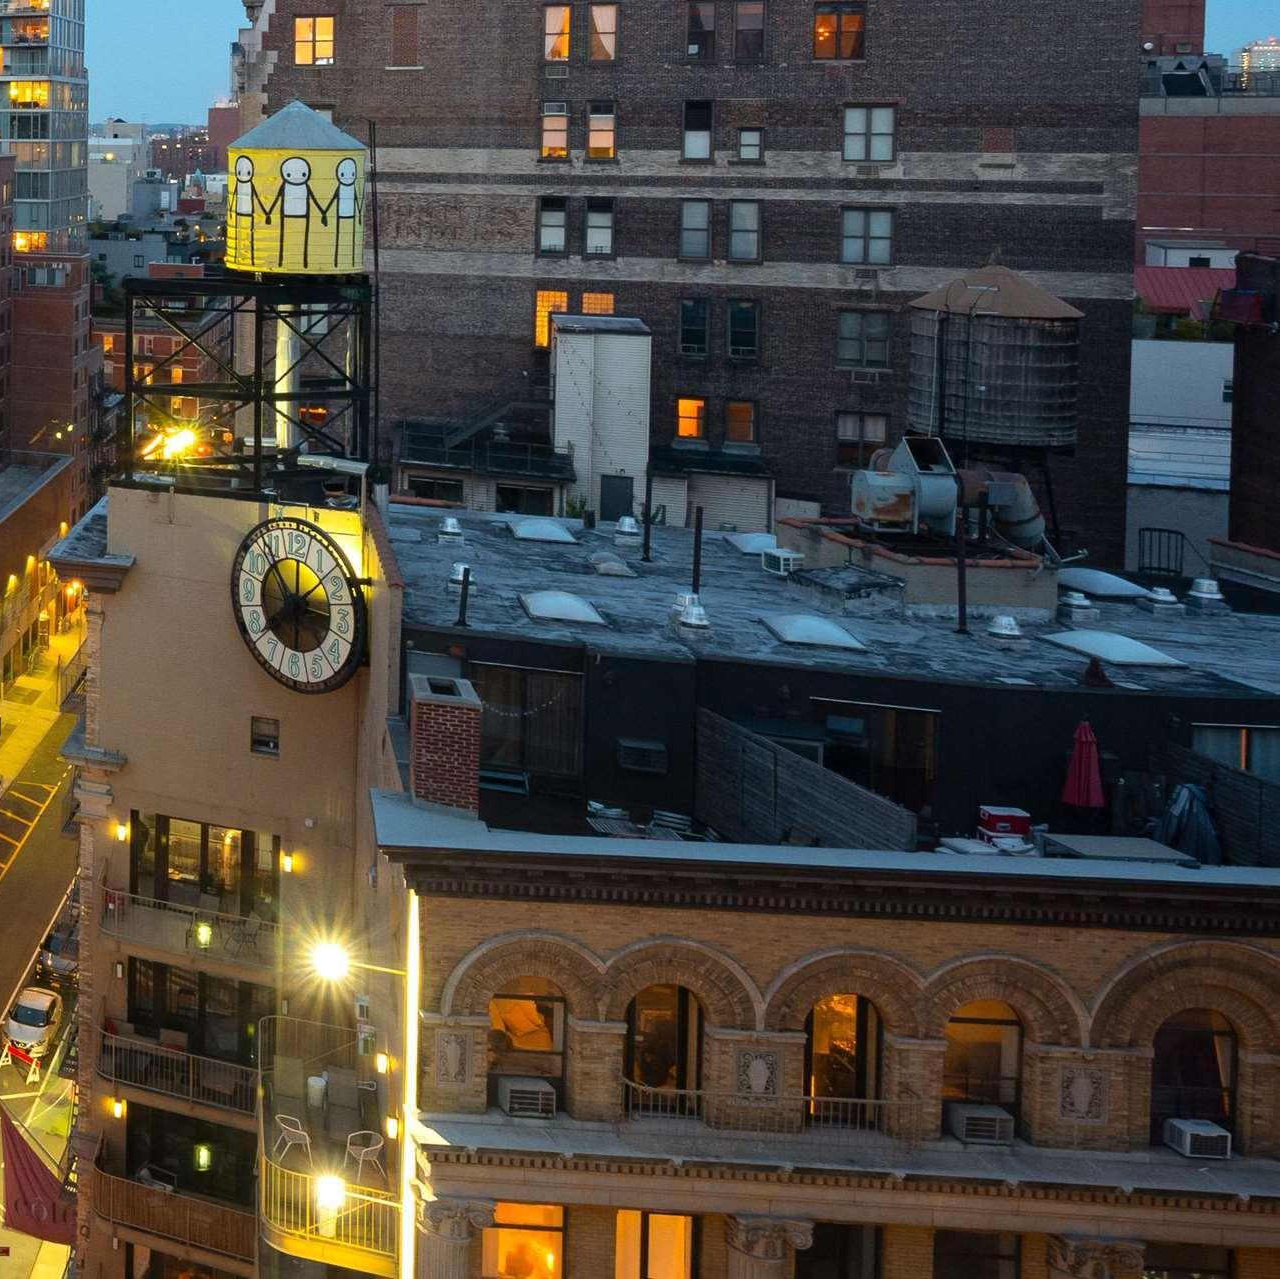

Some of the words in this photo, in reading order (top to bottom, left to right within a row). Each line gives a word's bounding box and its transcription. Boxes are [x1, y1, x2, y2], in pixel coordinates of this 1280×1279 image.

[267, 533, 280, 558] 11
[287, 532, 306, 558] 12
[248, 550, 265, 576] 10
[316, 549, 324, 573] 1
[243, 578, 255, 602] 9
[330, 576, 343, 601] 2
[249, 610, 260, 634] 8
[337, 608, 349, 634] 3
[267, 639, 278, 662] 7
[329, 639, 340, 665] 4
[288, 653, 299, 678] 6
[311, 654, 323, 679] 5
